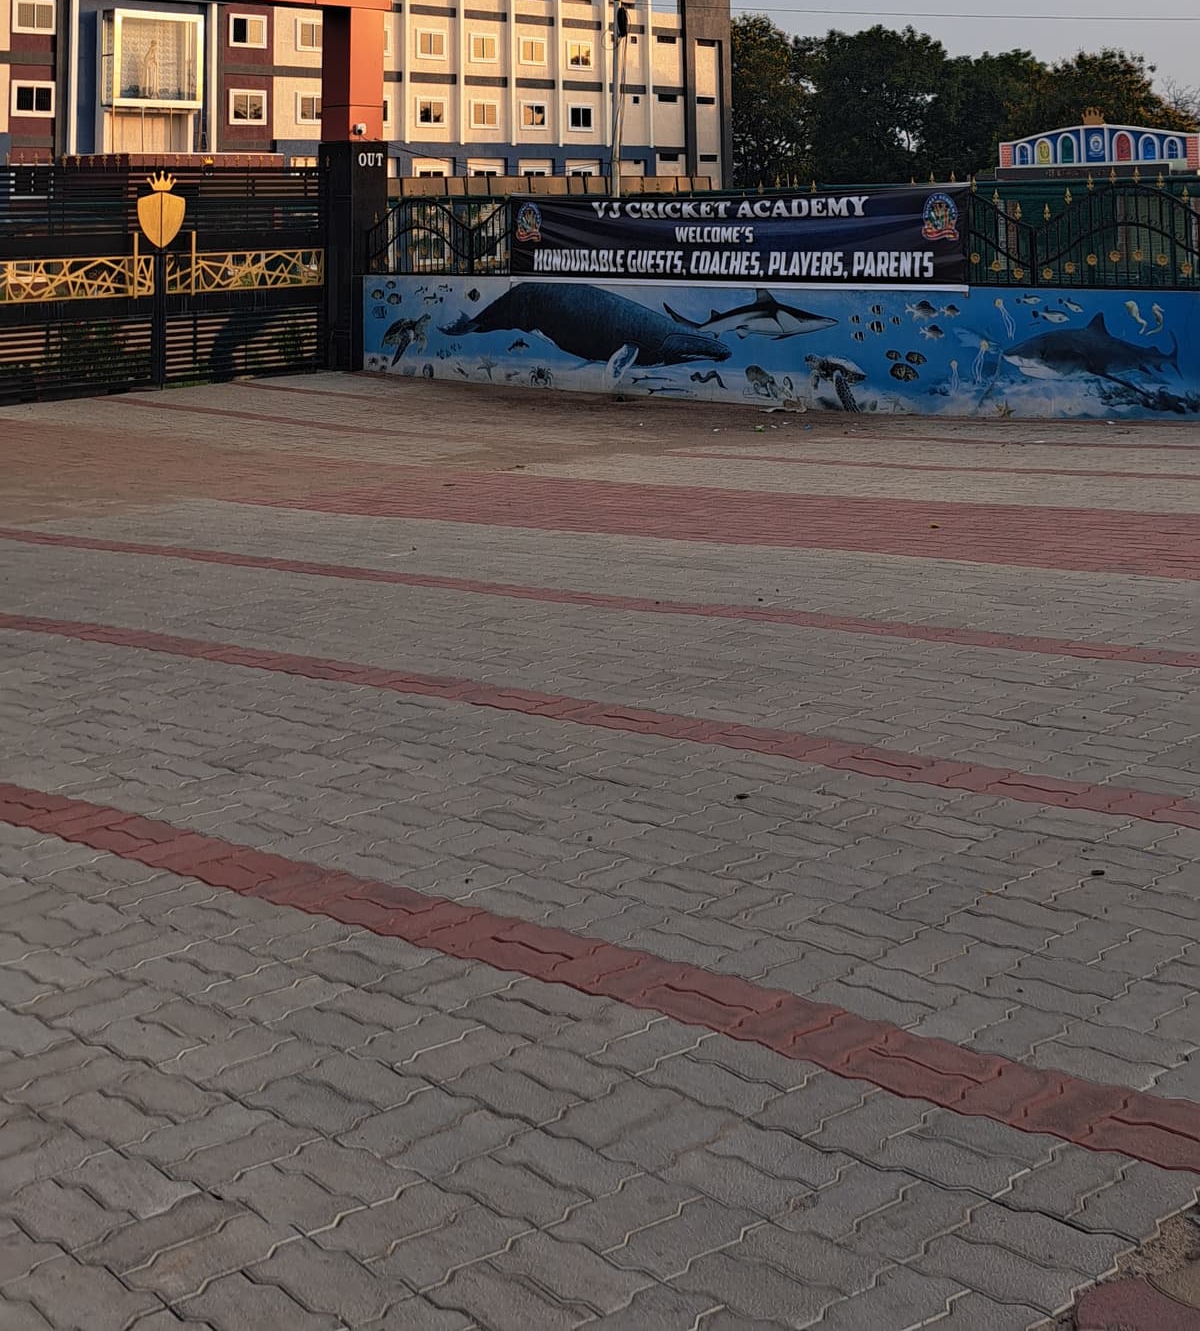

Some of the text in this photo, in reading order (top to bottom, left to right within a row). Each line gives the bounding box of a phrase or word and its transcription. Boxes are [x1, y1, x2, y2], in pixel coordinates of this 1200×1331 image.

[358, 152, 384, 166] OUT
[591, 196, 869, 219] VJ CRICKET ACADEMY
[675, 226, 754, 244] WELCOME'S
[533, 249, 935, 279] HONOURABLE GUESTS, COACHES, PLAYERS, PARENTS
